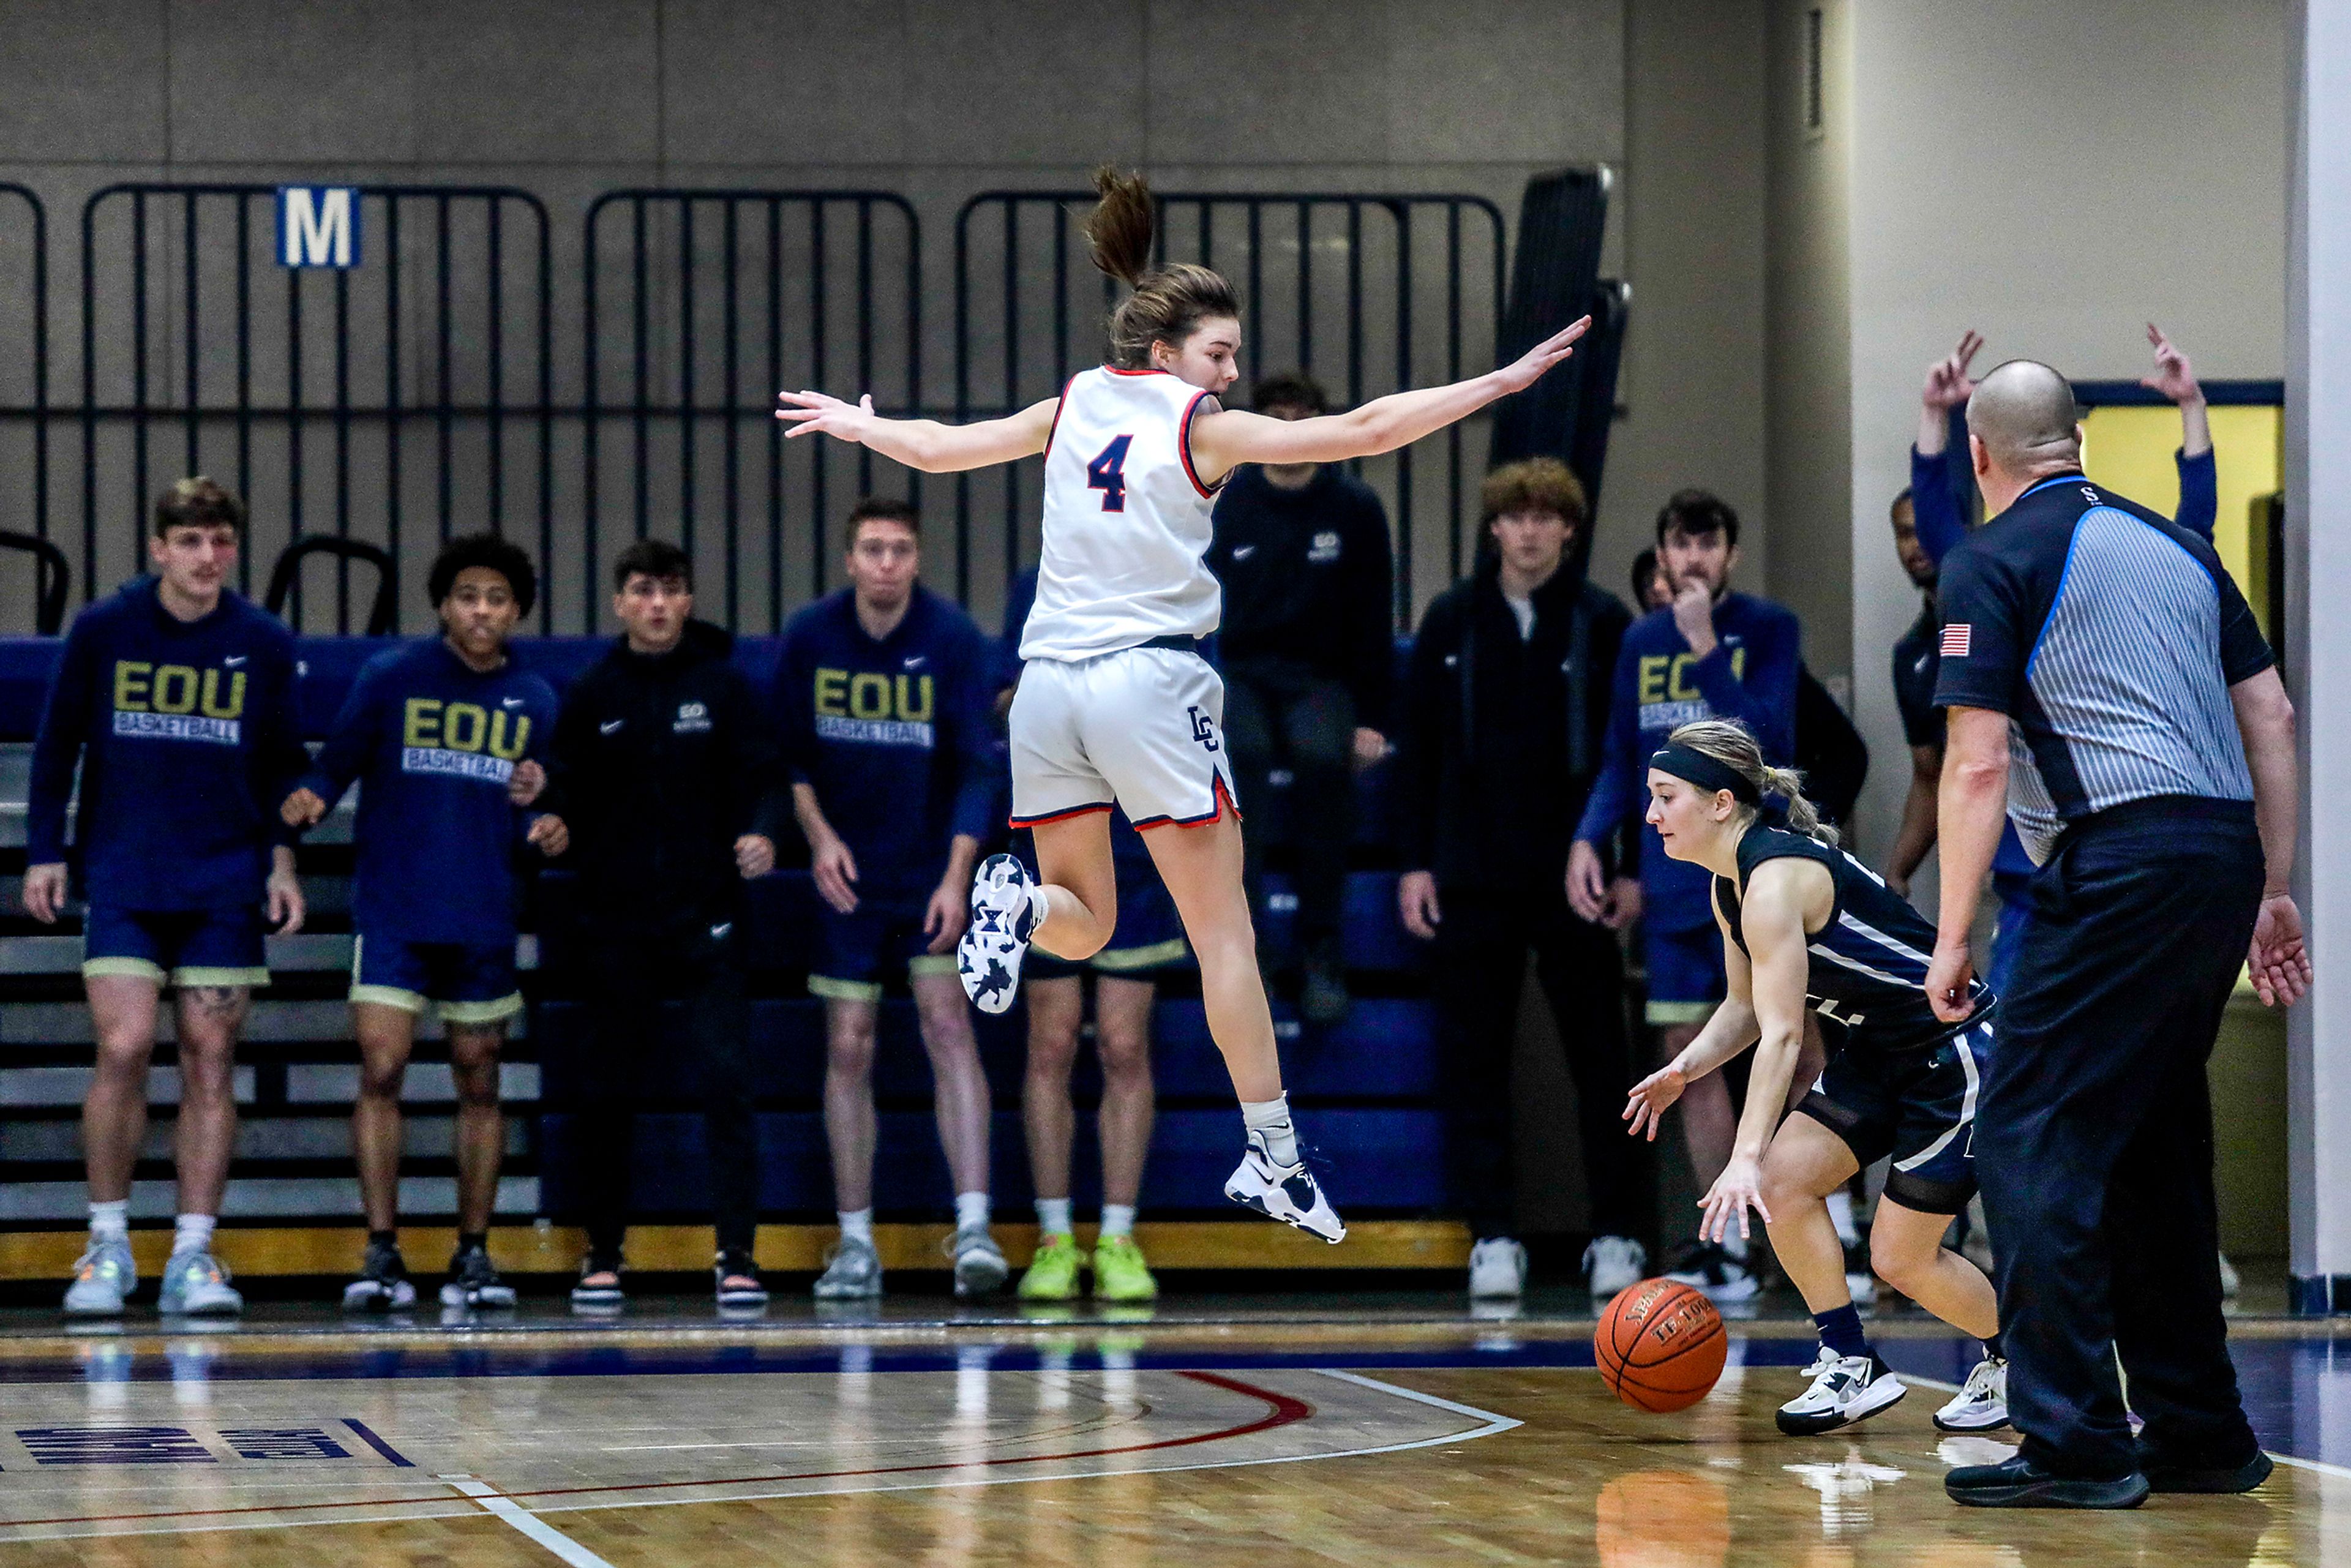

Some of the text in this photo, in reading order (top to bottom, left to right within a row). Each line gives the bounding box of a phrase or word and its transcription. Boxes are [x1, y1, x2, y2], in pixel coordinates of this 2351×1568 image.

[285, 187, 351, 266] M
[1087, 433, 1134, 512] 4
[114, 660, 247, 719] EOU
[814, 667, 934, 722] EOU
[404, 697, 531, 760] EOU
[1187, 705, 1219, 752] LC
